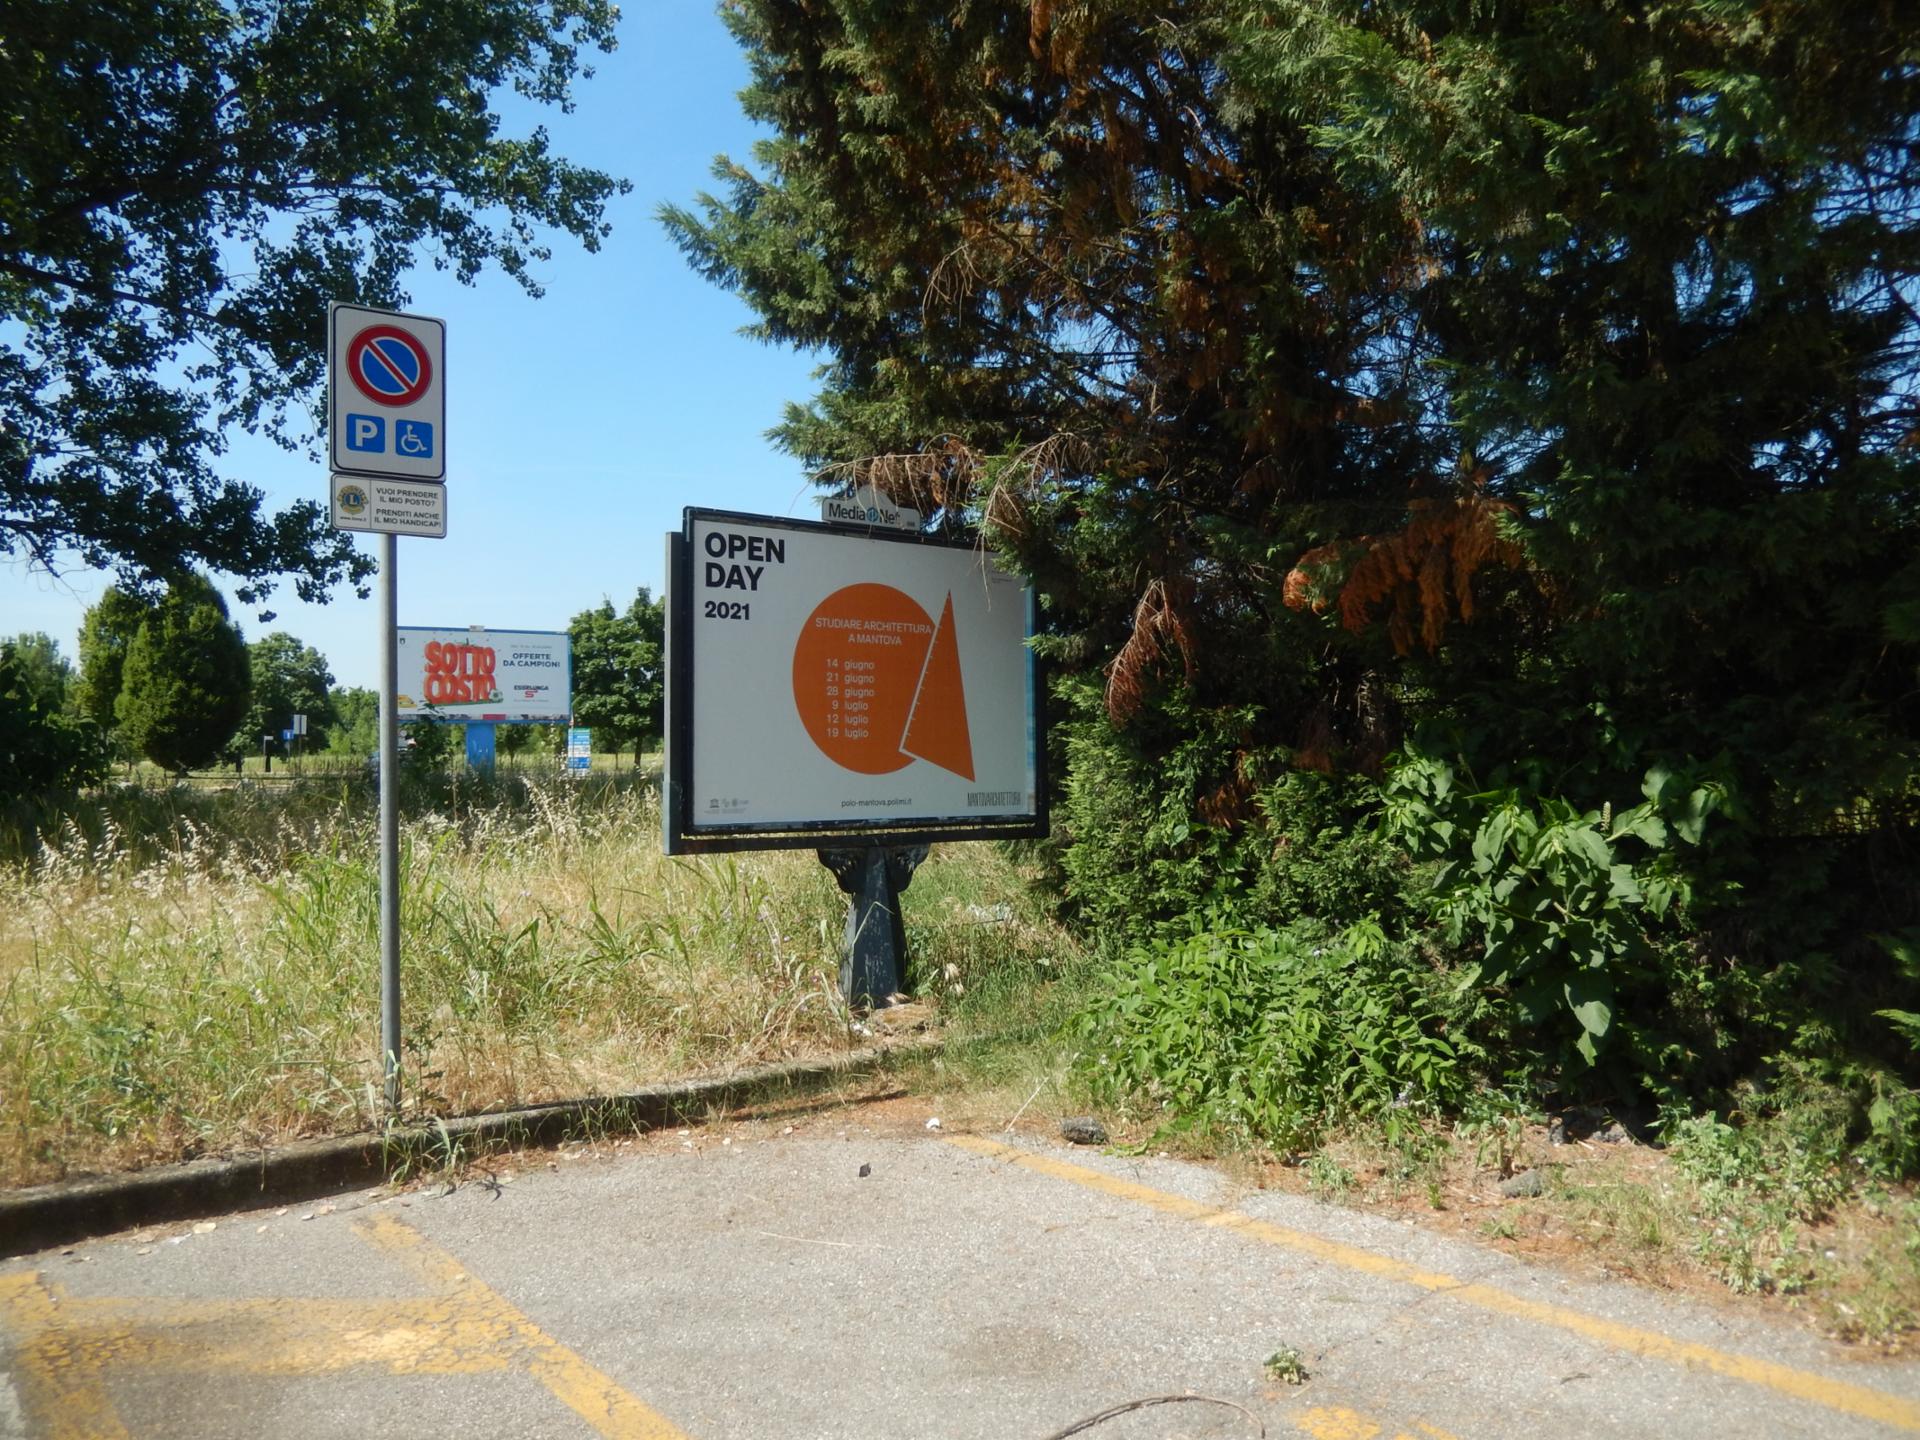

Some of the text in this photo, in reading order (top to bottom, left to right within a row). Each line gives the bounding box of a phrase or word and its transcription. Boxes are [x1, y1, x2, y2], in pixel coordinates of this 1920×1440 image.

[355, 419, 378, 447] P
[376, 488, 396, 496] VUOI
[397, 489, 439, 500] PRENDERE
[405, 498, 435, 507] POSTO?
[376, 509, 440, 520] PRENDITI ANCHE
[828, 503, 866, 520] Media
[383, 517, 398, 525] MIO
[705, 532, 785, 564] OPEN
[705, 562, 764, 591] DAY
[704, 600, 750, 621] 2021
[815, 617, 932, 634] STUDIARE ARCHITETTURA
[848, 633, 903, 646] A MANTOVA
[424, 641, 496, 674] SOTTO
[512, 652, 552, 660] OFFERTE
[517, 660, 561, 668] CAMPIONI
[826, 658, 875, 671] 14 giugno
[826, 672, 875, 685] 21 giugno
[424, 673, 497, 704] COSTO
[826, 686, 875, 698] 28 giugno
[831, 700, 869, 712] 9 luglio
[826, 714, 869, 726] 12 luglio
[826, 728, 869, 739] 19 luglio
